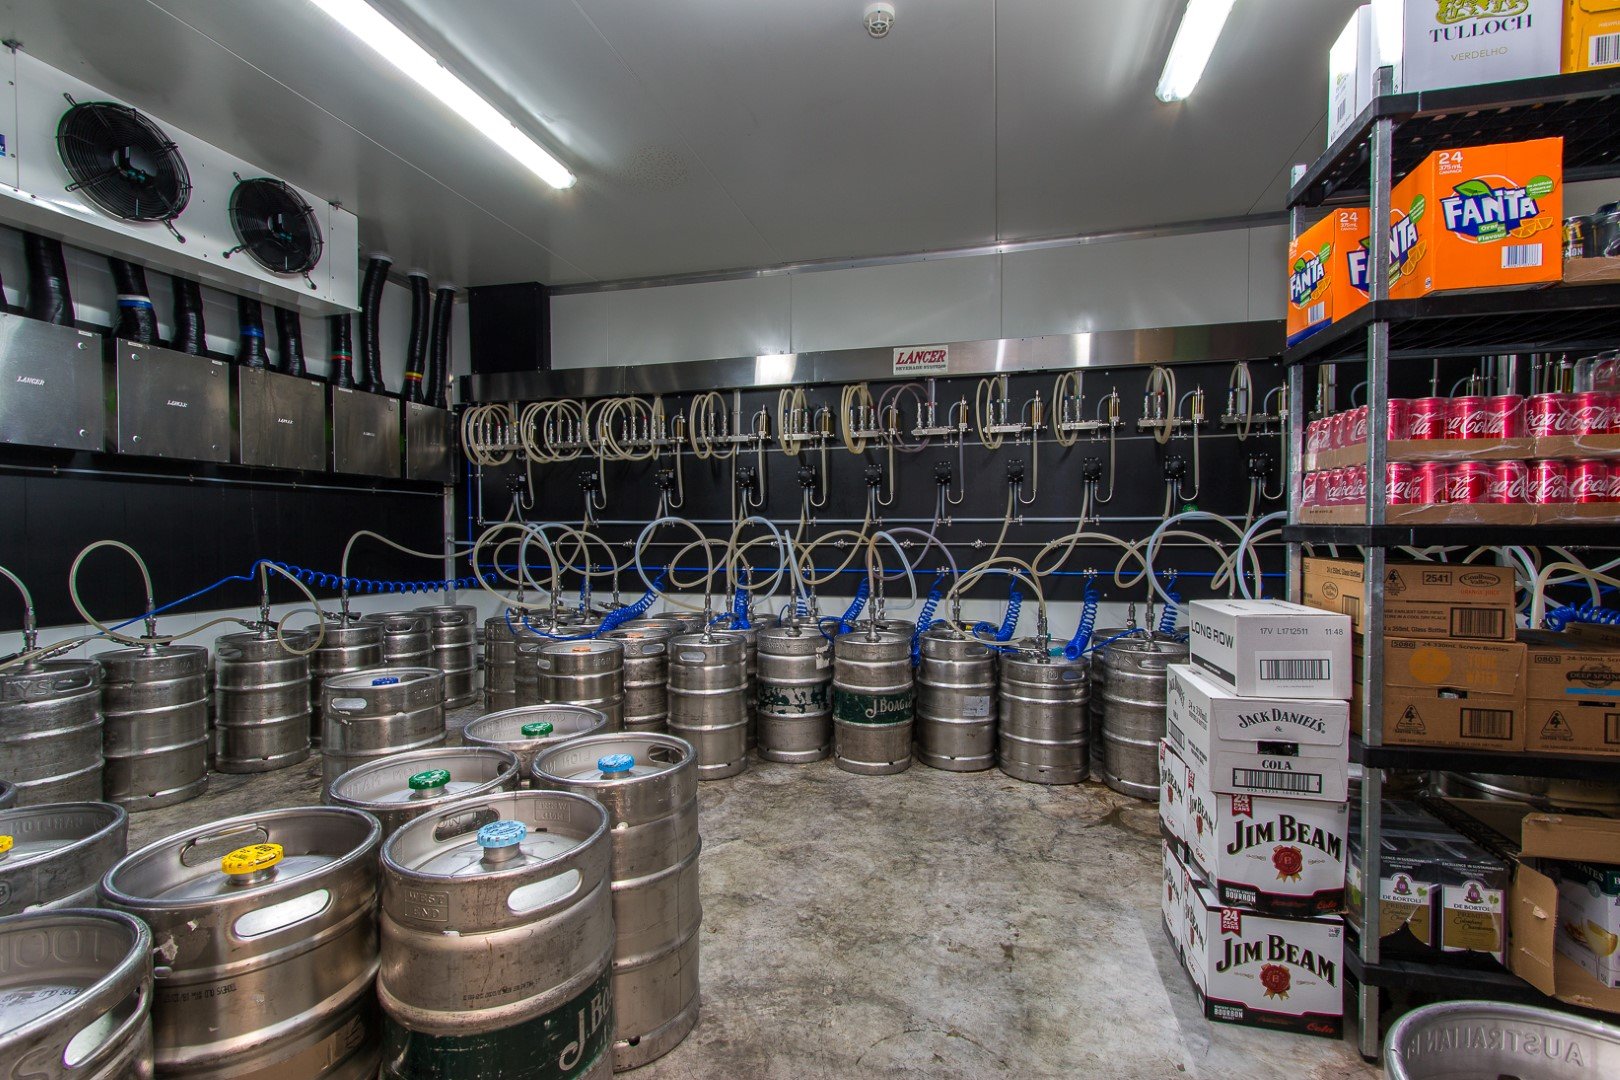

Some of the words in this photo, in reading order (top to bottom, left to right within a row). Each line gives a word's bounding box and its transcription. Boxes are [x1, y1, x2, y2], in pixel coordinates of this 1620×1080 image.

[1429, 14, 1532, 43] TULLOCH
[1451, 46, 1509, 61] VERDELHO
[1439, 151, 1463, 165] 24
[1441, 188, 1538, 229] FANTA
[1340, 212, 1358, 222] 24
[1290, 256, 1325, 302] FANTA
[896, 350, 947, 365] LANCER
[17, 375, 45, 386] LANCER
[1426, 574, 1449, 583] 2541
[1191, 620, 1212, 639] LONG
[1213, 634, 1234, 649] ROW
[1260, 627, 1273, 635] 17V
[1325, 628, 1344, 636] 11:48
[1237, 711, 1269, 729] JACK
[1272, 708, 1325, 734] DANIEL'S
[1262, 759, 1293, 770] COLA
[1234, 794, 1249, 803] 24
[1226, 819, 1275, 855] JIM
[1278, 814, 1343, 863] BEAM
[1225, 891, 1256, 902] BOURBON
[1222, 909, 1238, 921] 24
[1216, 937, 1264, 973] JIM
[1267, 933, 1337, 989] BEAM
[1214, 1007, 1243, 1018] BOURBON
